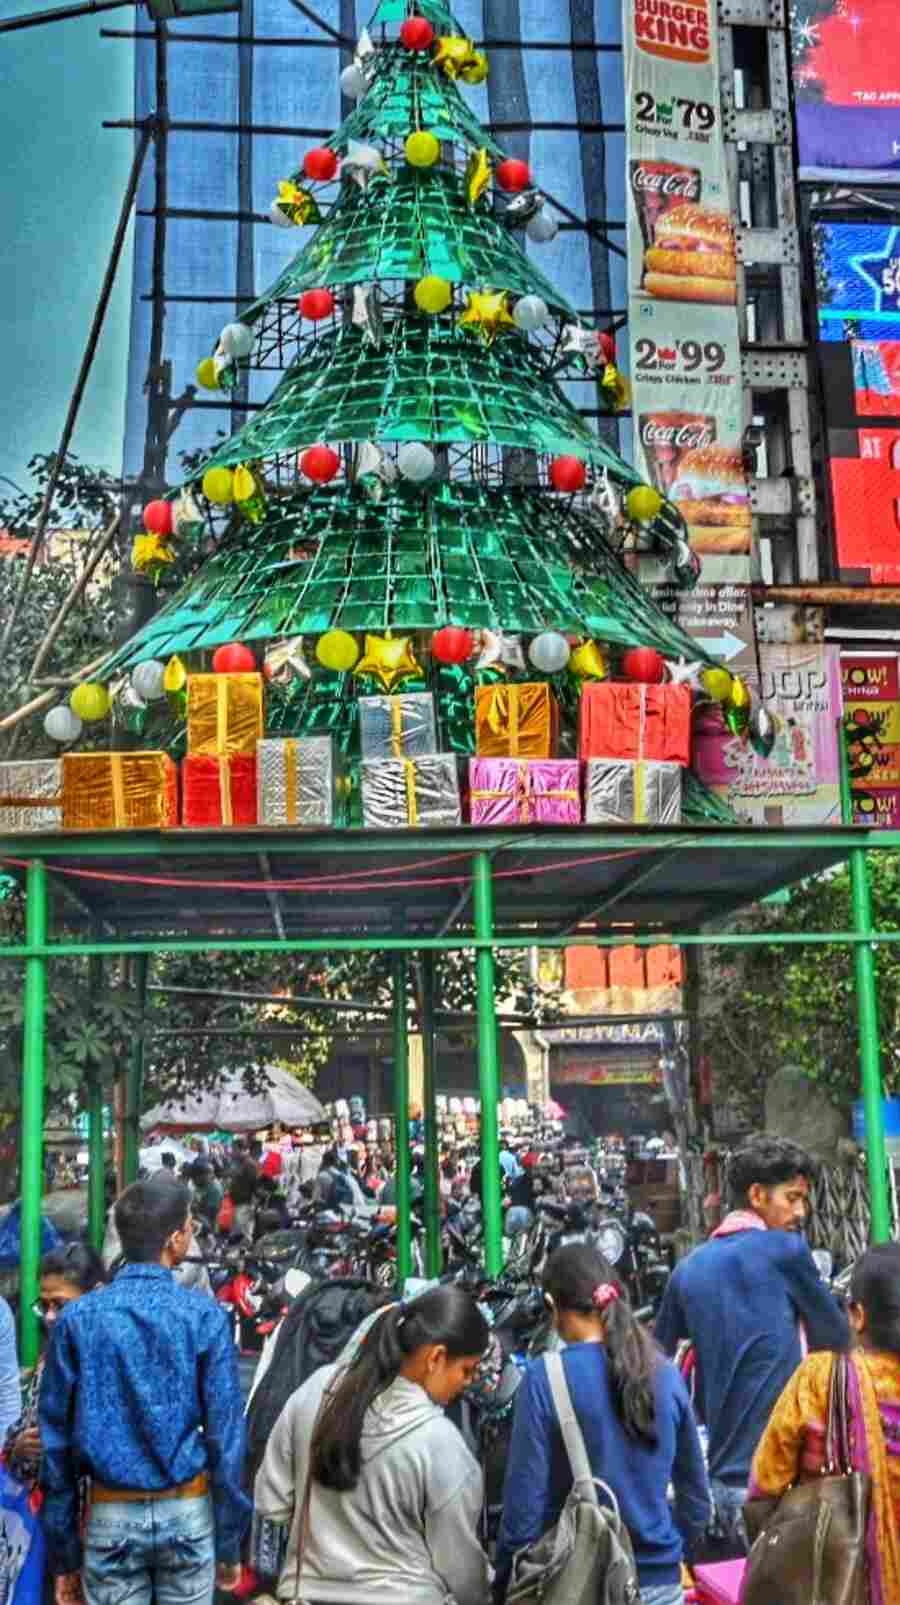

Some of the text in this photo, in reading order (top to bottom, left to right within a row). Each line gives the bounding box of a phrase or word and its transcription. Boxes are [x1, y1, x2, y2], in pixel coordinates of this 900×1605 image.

[635, 0, 708, 27] BURGER
[635, 14, 710, 50] KING
[635, 92, 655, 122] 2
[635, 338, 656, 368] 2
[635, 374, 663, 385] Crispy
[665, 374, 702, 385] Chicken
